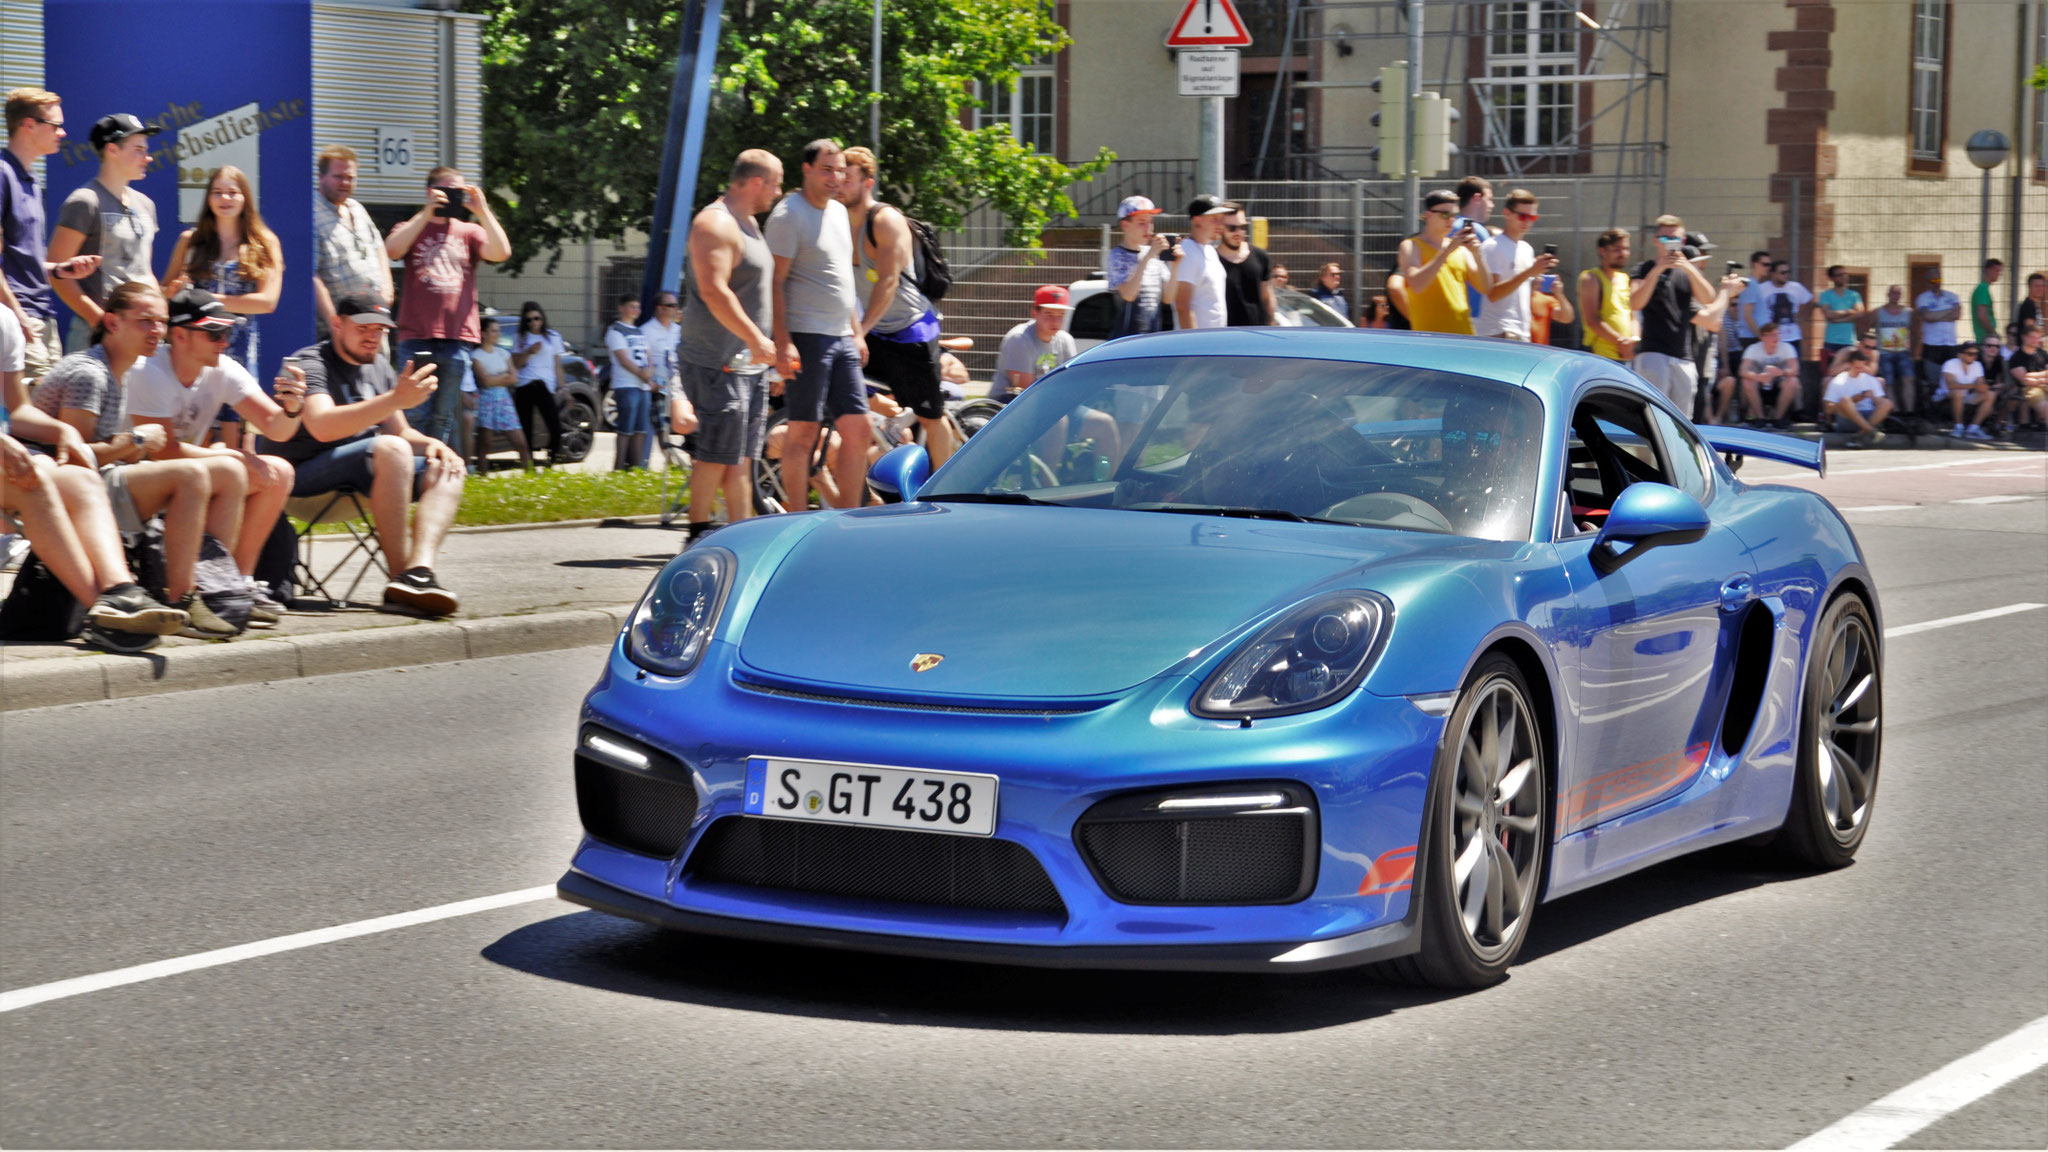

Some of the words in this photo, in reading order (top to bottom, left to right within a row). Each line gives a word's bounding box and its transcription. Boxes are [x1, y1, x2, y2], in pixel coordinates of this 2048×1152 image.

[383, 138, 409, 165] 66
[749, 792, 759, 805] D
[777, 769, 801, 810] S
[828, 773, 881, 817] GT
[892, 778, 972, 824] 438
